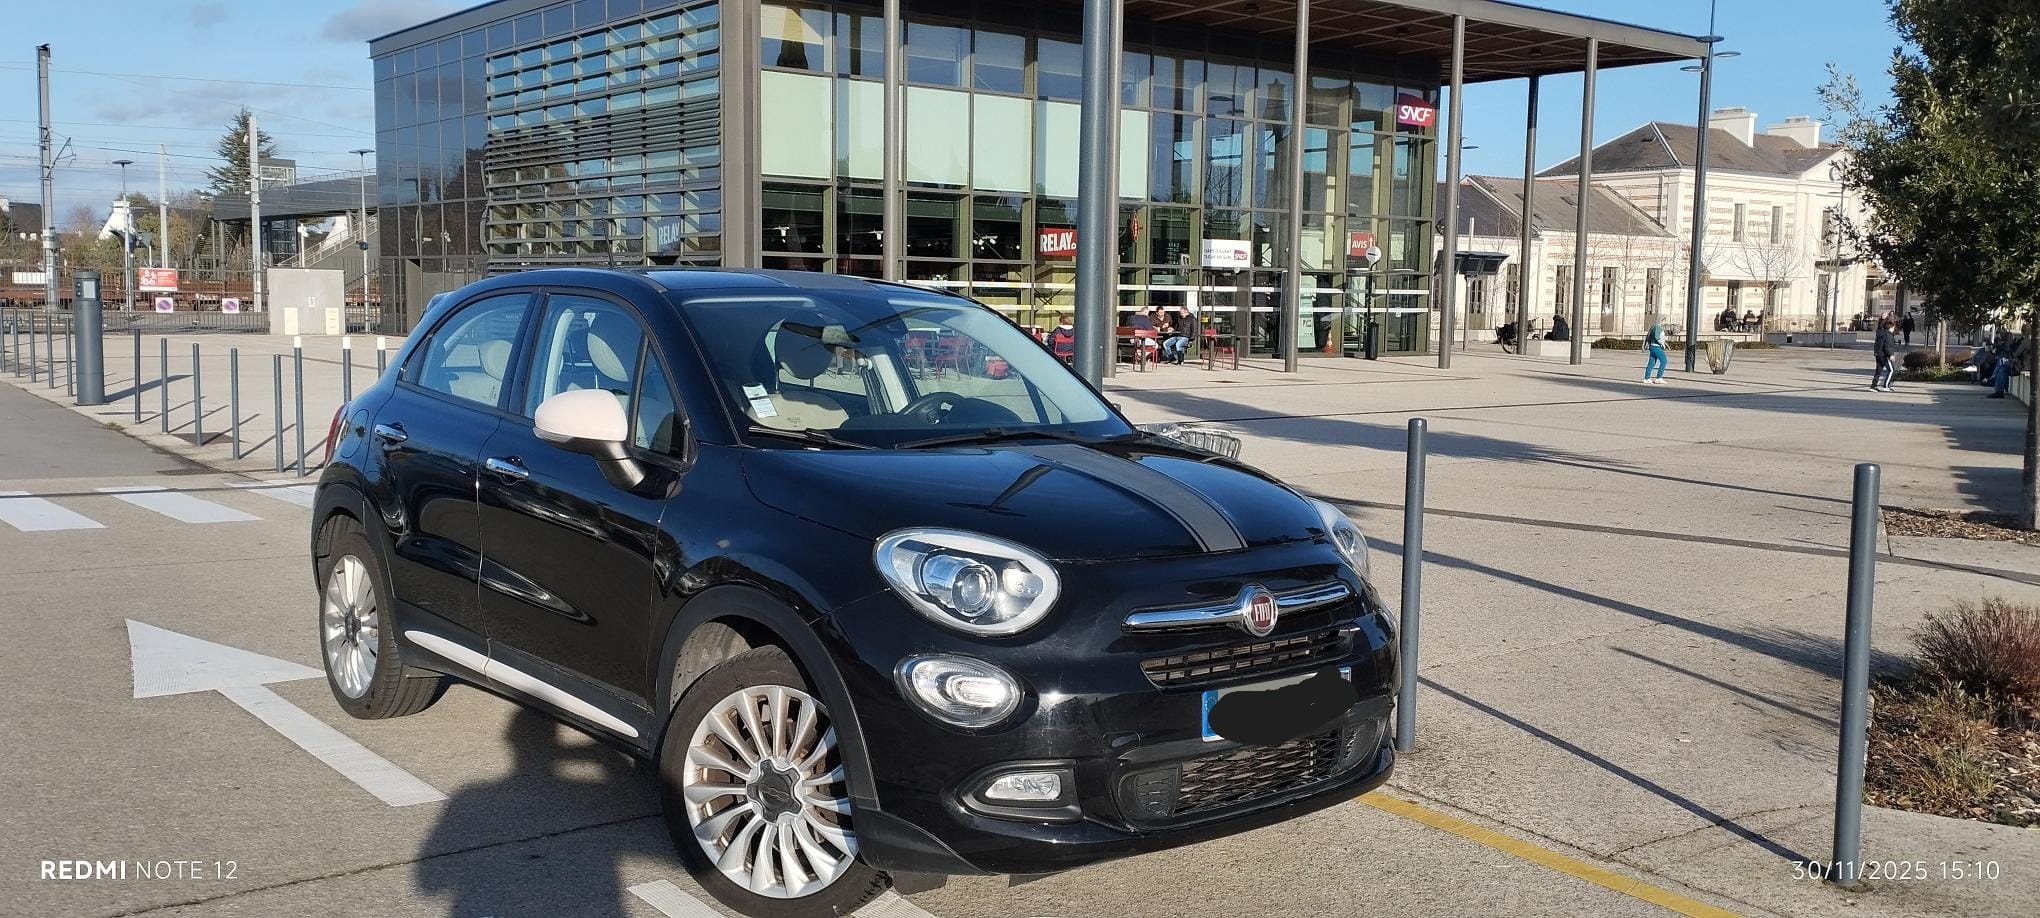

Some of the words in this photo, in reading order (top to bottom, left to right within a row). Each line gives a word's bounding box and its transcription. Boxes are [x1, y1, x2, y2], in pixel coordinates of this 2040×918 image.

[1400, 105, 1432, 121] SNCF
[1351, 240, 1368, 249] AVIS
[1254, 603, 1270, 621] FIAT
